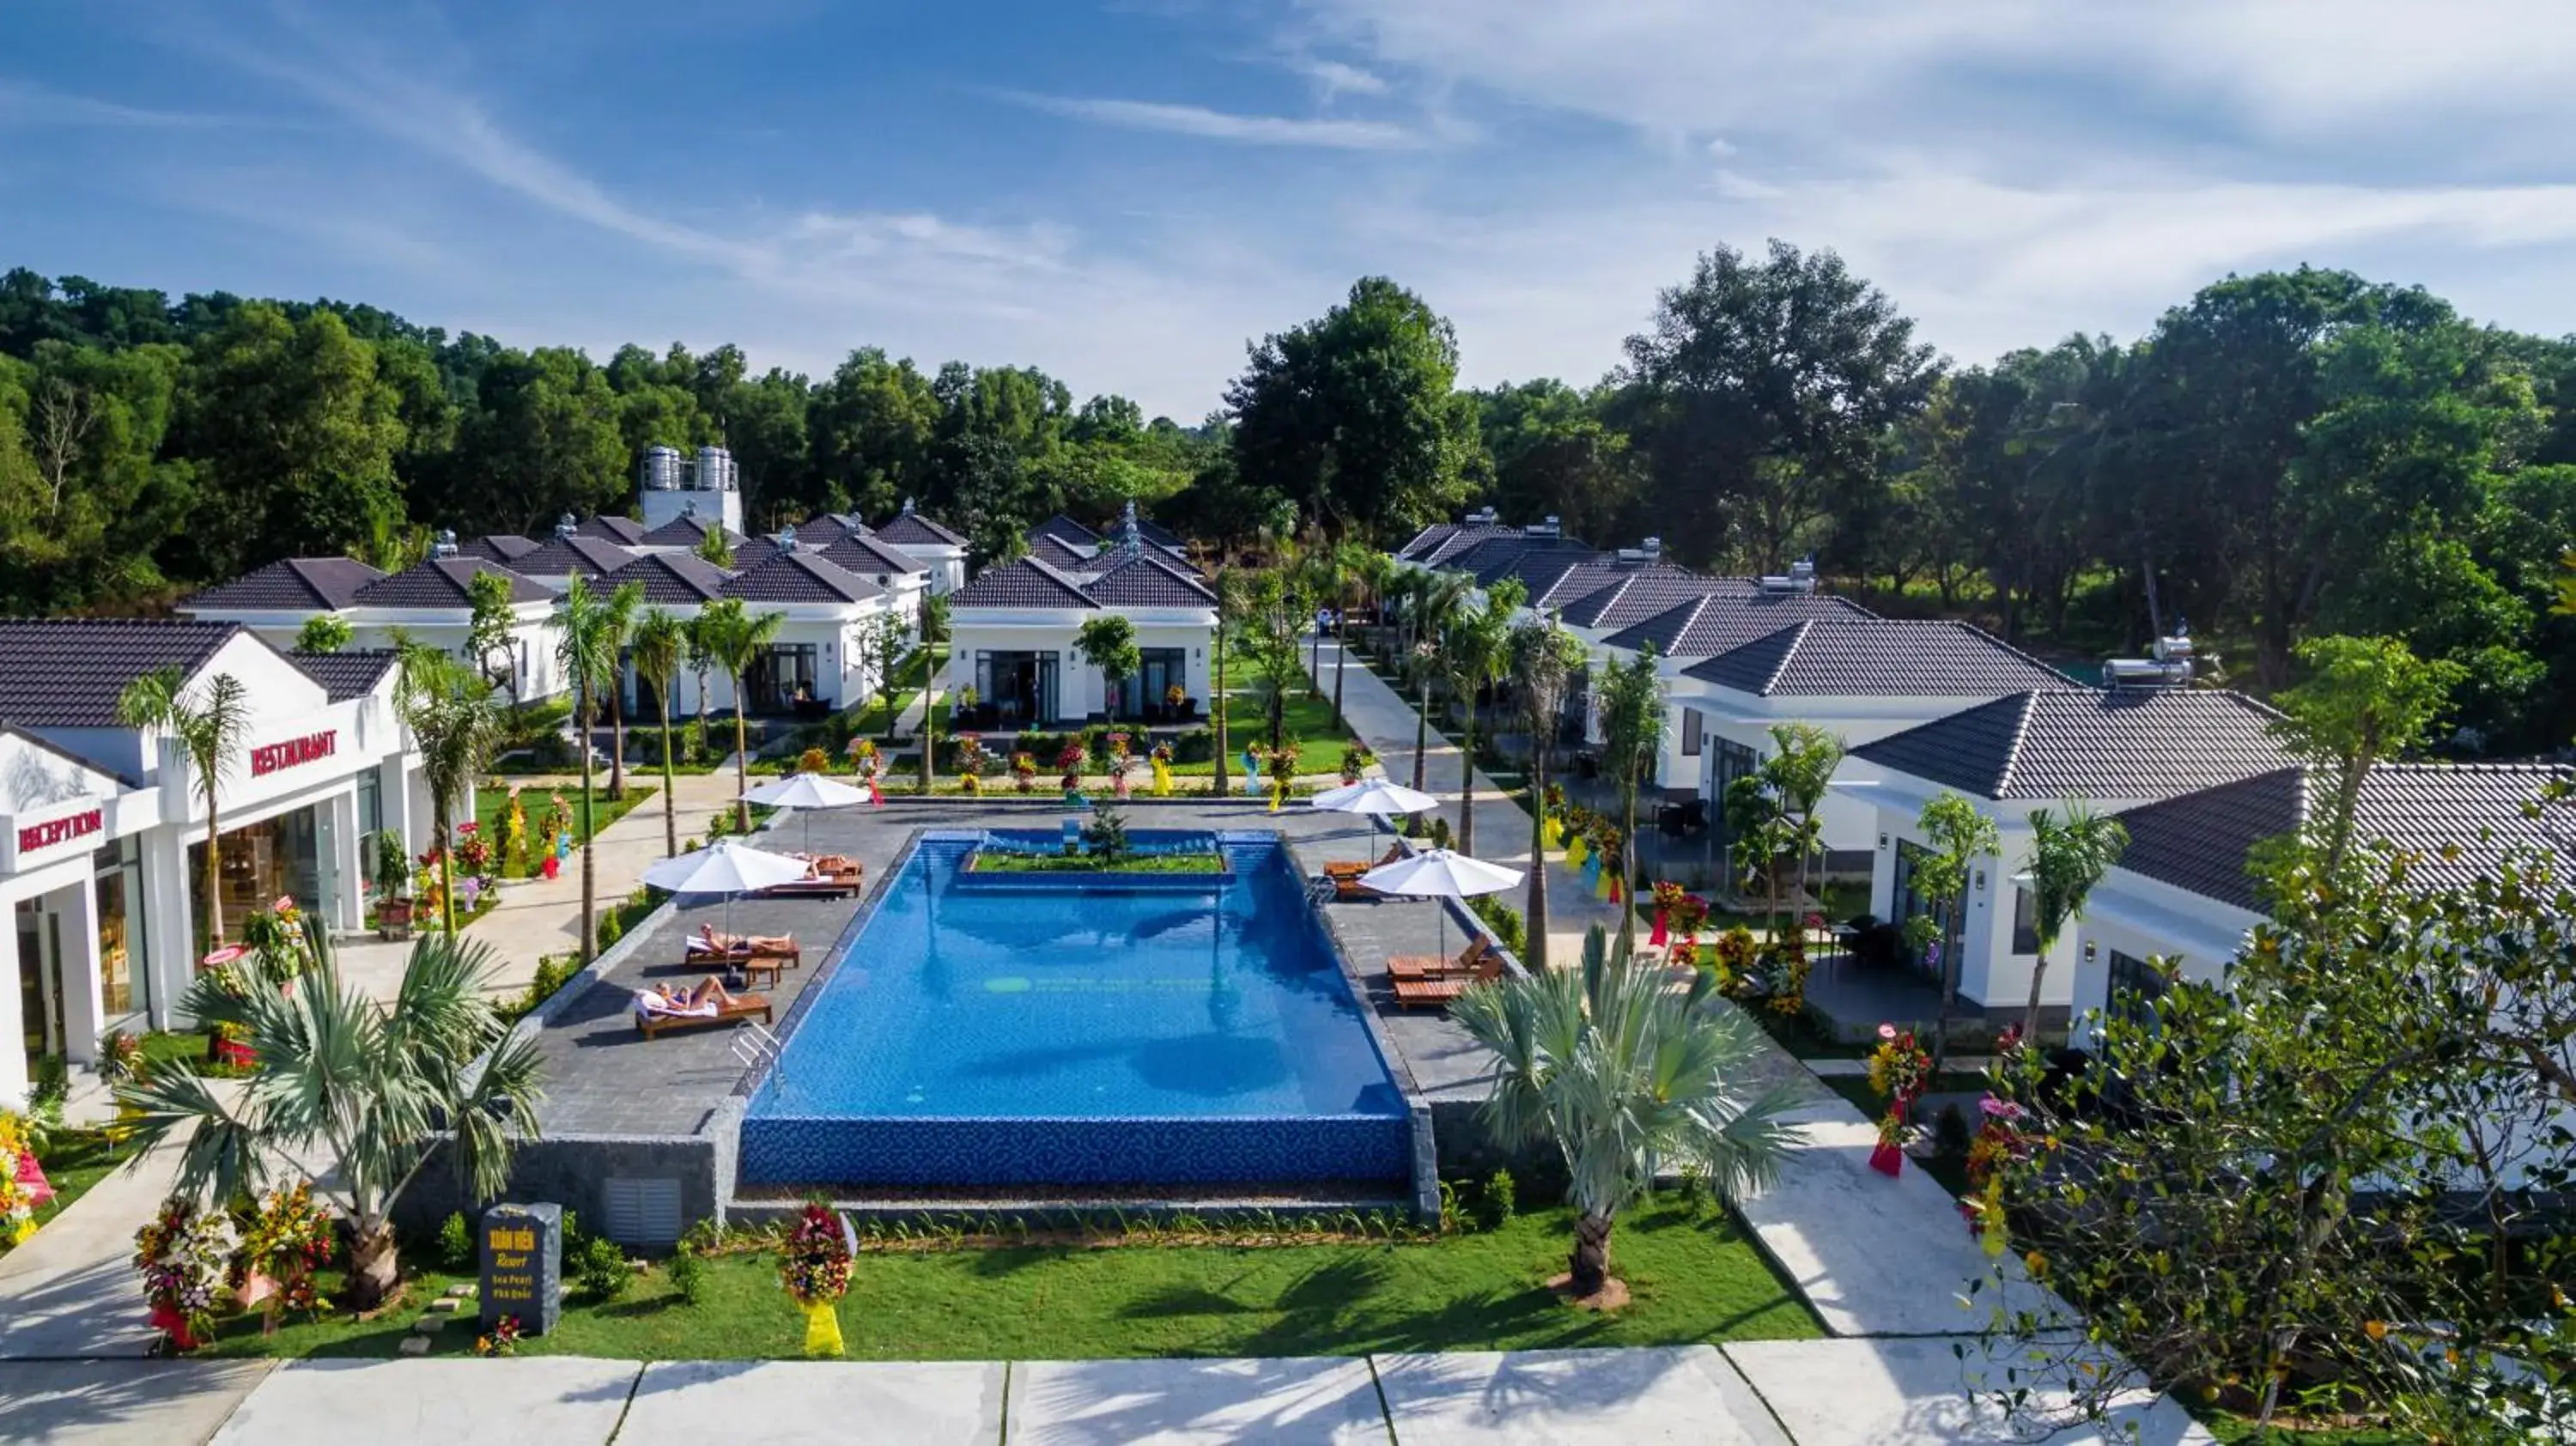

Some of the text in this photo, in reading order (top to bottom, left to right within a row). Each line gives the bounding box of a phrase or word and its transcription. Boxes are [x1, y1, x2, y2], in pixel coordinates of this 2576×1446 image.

[250, 728, 337, 779] RESTAURANT
[18, 807, 101, 854] RECEPTION
[496, 1252, 527, 1267] Resort
